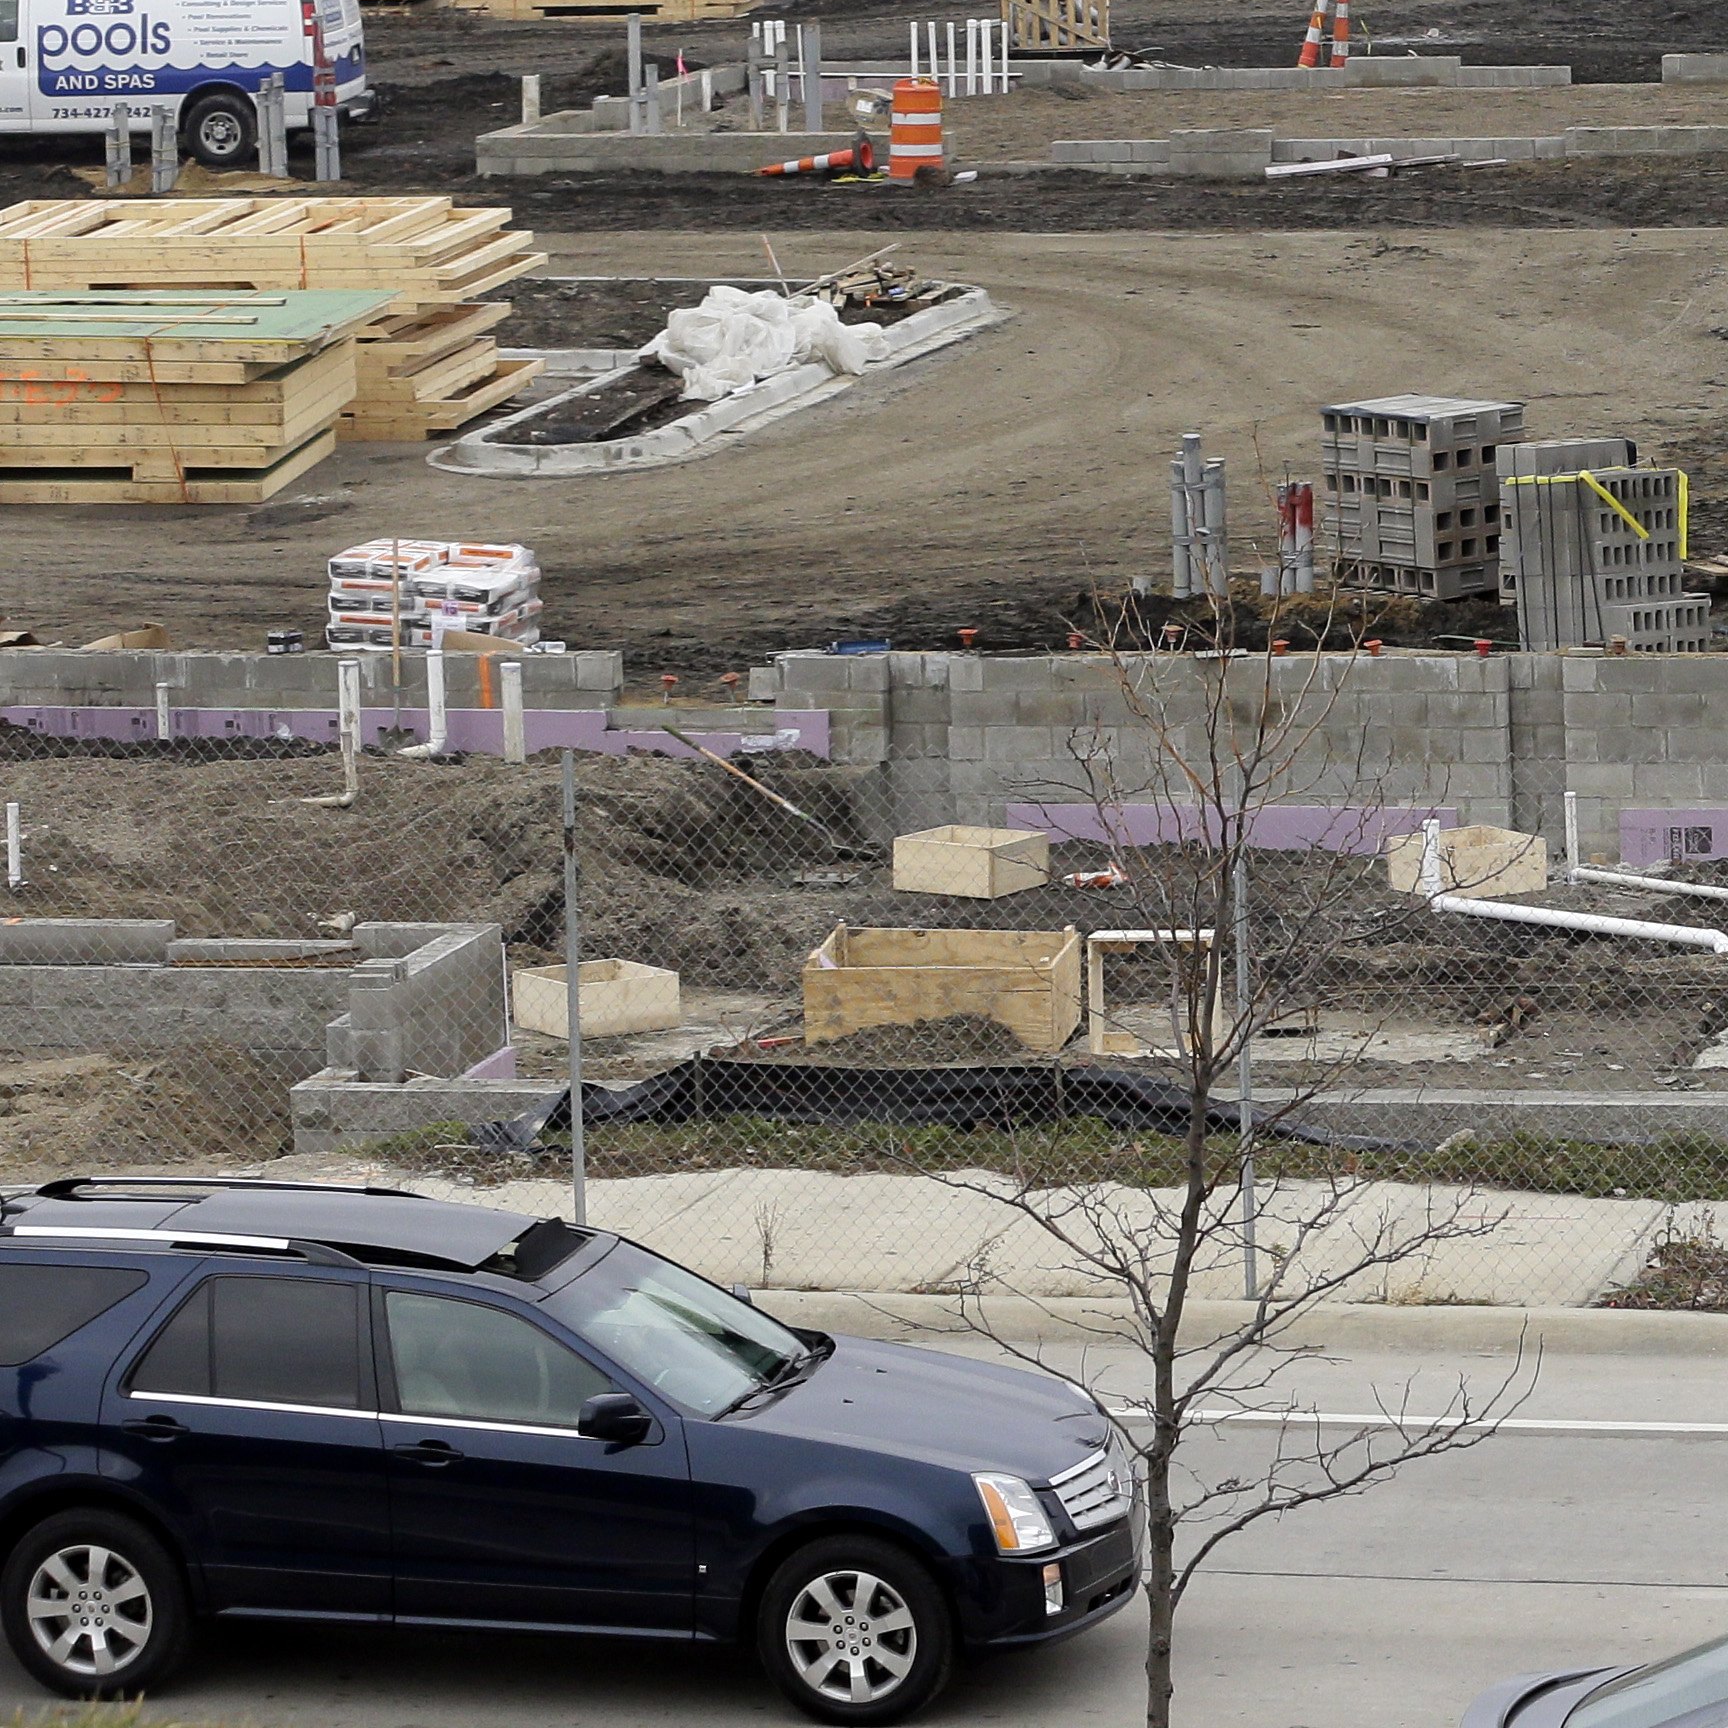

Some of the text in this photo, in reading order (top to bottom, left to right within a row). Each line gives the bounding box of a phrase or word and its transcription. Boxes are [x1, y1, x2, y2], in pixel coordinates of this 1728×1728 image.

[37, 12, 172, 69] pools
[55, 74, 156, 91] AND SPAS
